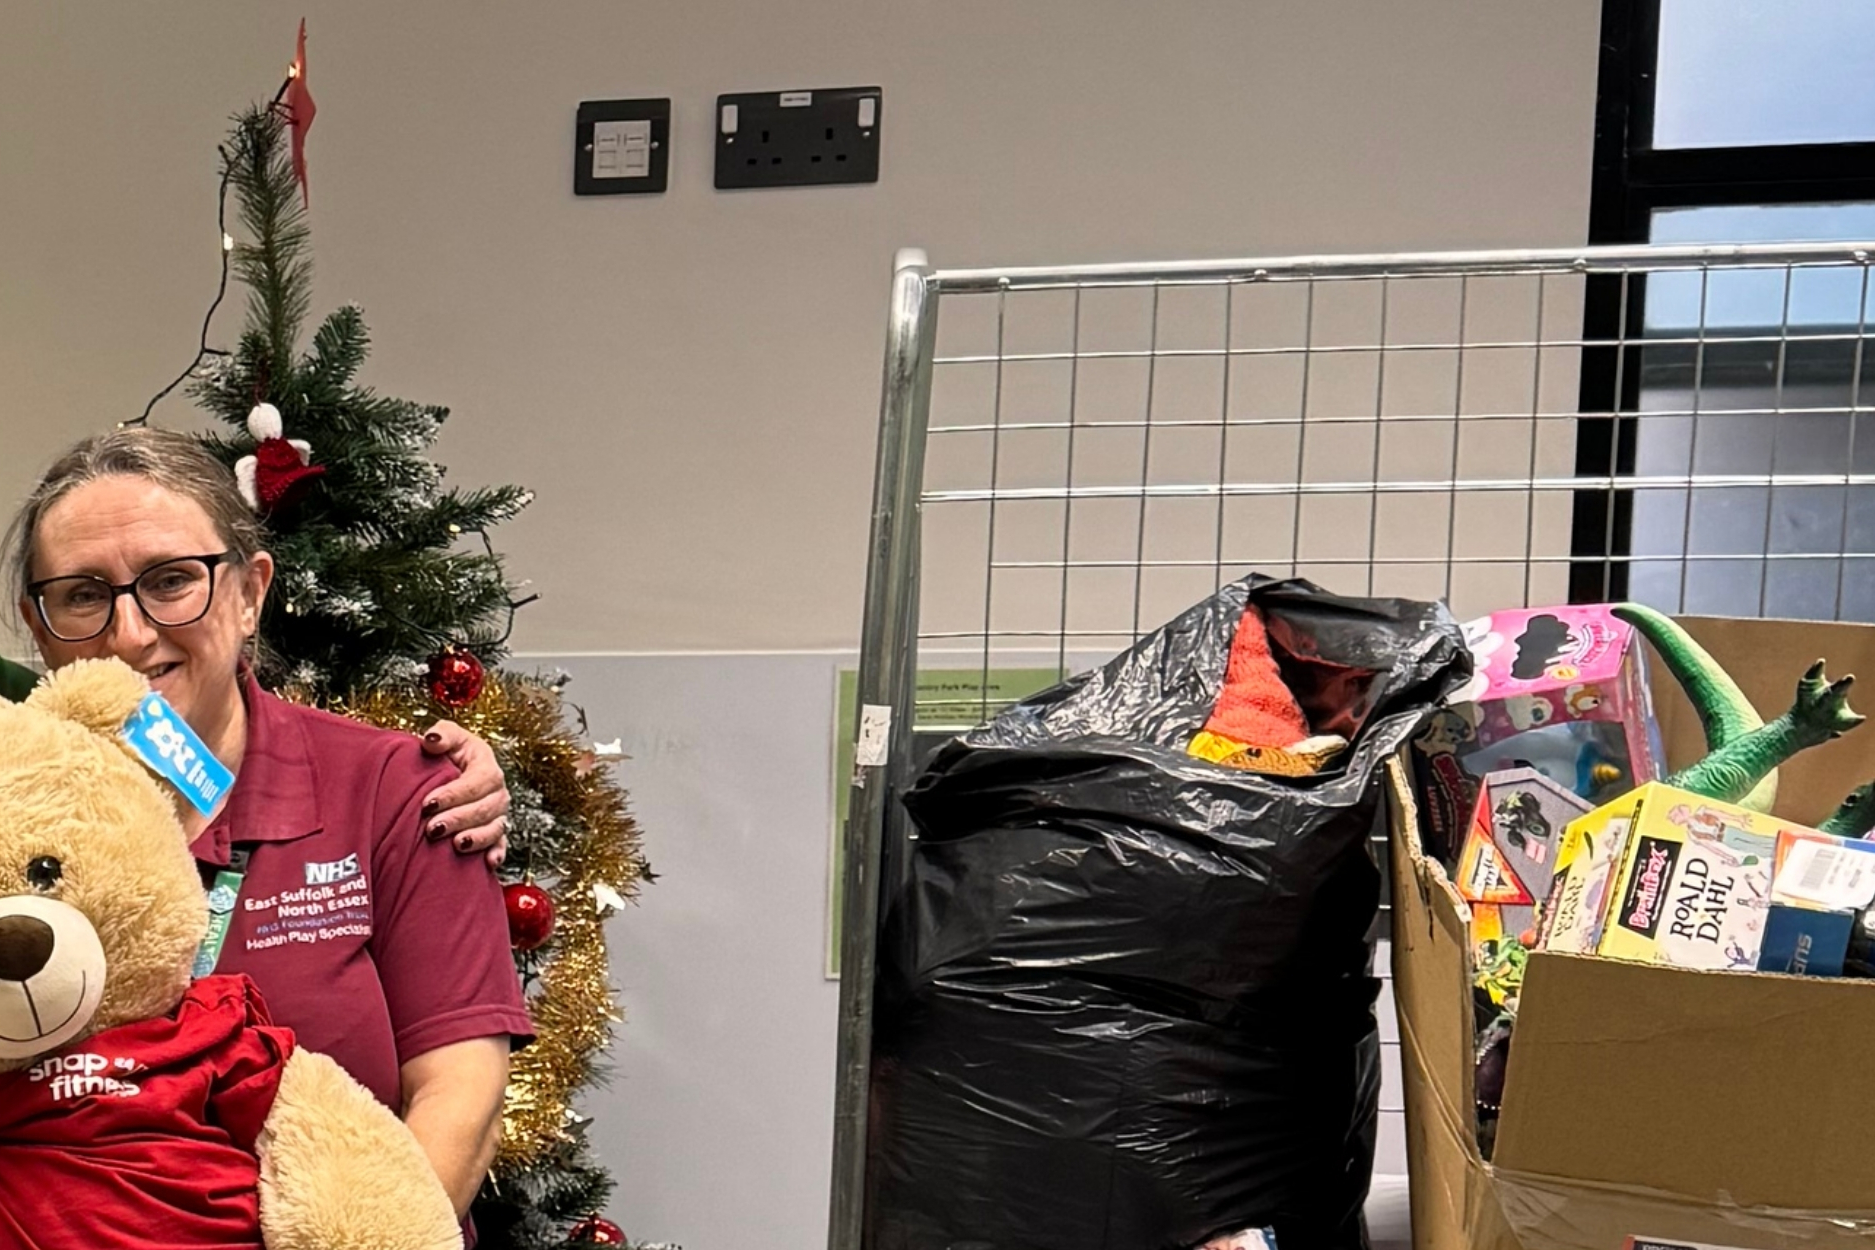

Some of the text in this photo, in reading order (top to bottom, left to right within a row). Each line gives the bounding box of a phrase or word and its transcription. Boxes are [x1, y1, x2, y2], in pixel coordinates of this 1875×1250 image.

[306, 853, 359, 885] NHS
[244, 897, 278, 911] East
[280, 885, 336, 904] Suffolk
[339, 875, 367, 894] and
[1628, 846, 1668, 928] BrainBox
[1670, 858, 1710, 940] ROALD
[278, 894, 369, 919] North Essex
[1696, 875, 1735, 944] DAHL
[246, 935, 288, 950] Health
[289, 929, 318, 944] Play
[29, 1053, 109, 1082] snap
